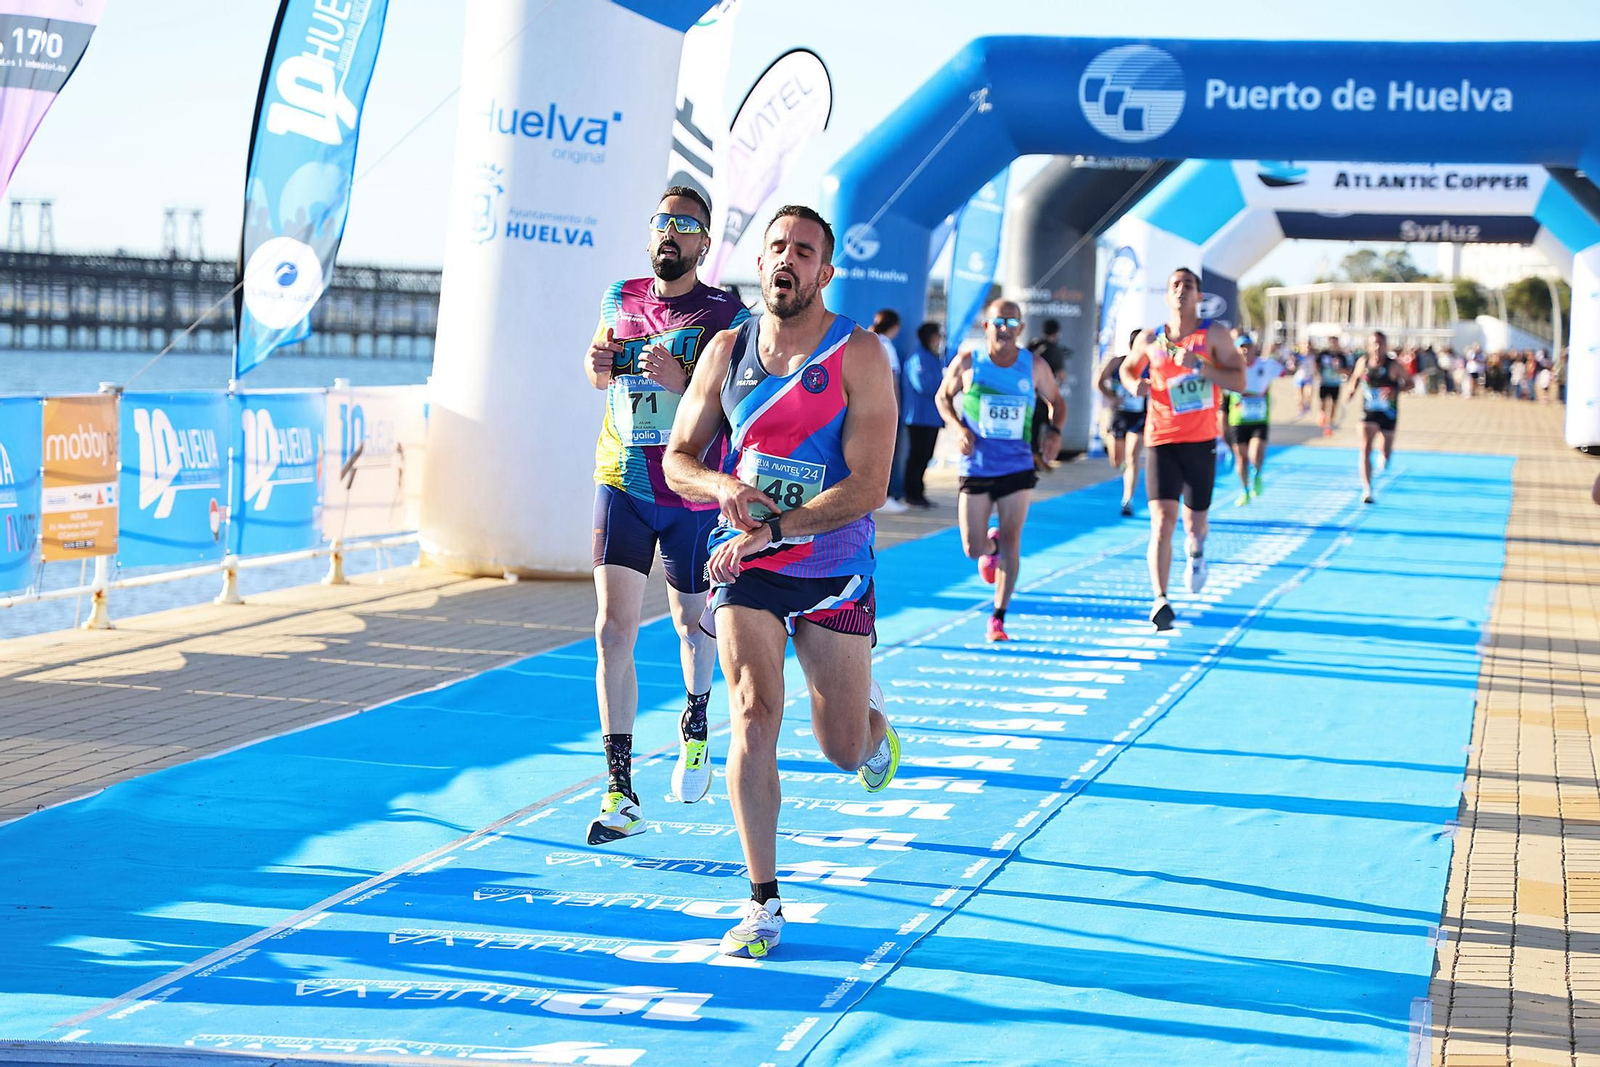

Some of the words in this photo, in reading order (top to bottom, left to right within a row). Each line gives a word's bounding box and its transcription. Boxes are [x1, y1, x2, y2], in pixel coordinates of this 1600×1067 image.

[12, 27, 63, 58] 170
[1205, 79, 1322, 110] Puerto
[1331, 78, 1376, 111] de
[1387, 79, 1514, 112] Huelva
[478, 98, 609, 146] Huelva
[552, 148, 606, 164] original
[508, 207, 580, 224] Ayuntamiento
[582, 214, 598, 226] de
[506, 221, 594, 247] HUELVA
[1178, 379, 1207, 394] 107
[629, 392, 657, 414] 71
[989, 406, 1019, 420] 683
[134, 408, 179, 519] 10
[178, 429, 219, 470] HUELVA
[242, 408, 280, 511] 10
[278, 427, 313, 466] HUELVA
[754, 458, 770, 468] ELVA
[772, 463, 800, 474] AVATEL
[801, 466, 819, 481] '24
[473, 892, 691, 911] HUELVA
[389, 933, 628, 955] HUELVA
[295, 984, 552, 1006] HUELVA
[298, 979, 452, 989] DESCUBRIMIENTO
[496, 985, 558, 995] PUERTA
[541, 985, 714, 1022] 10
